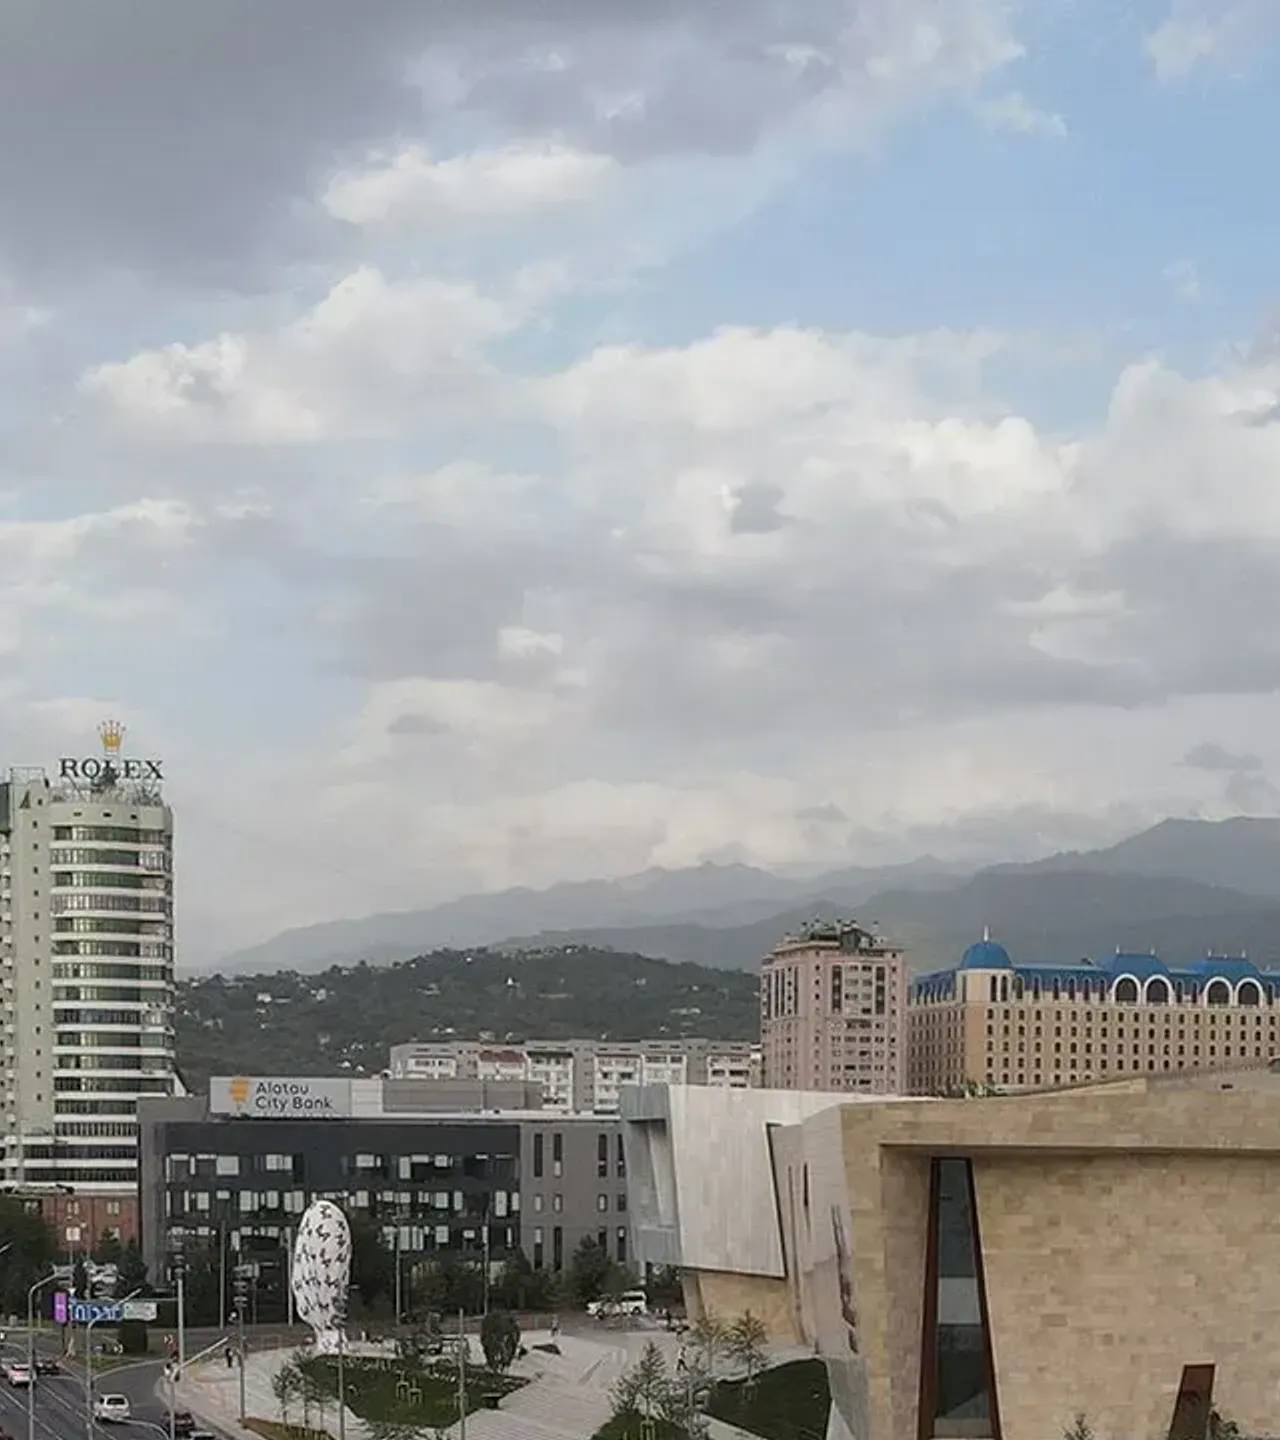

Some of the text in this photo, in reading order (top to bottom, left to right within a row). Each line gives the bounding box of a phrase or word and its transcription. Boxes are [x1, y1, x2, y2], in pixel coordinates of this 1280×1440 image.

[255, 1082, 310, 1096] Alatau
[255, 1096, 333, 1112] City Bank
